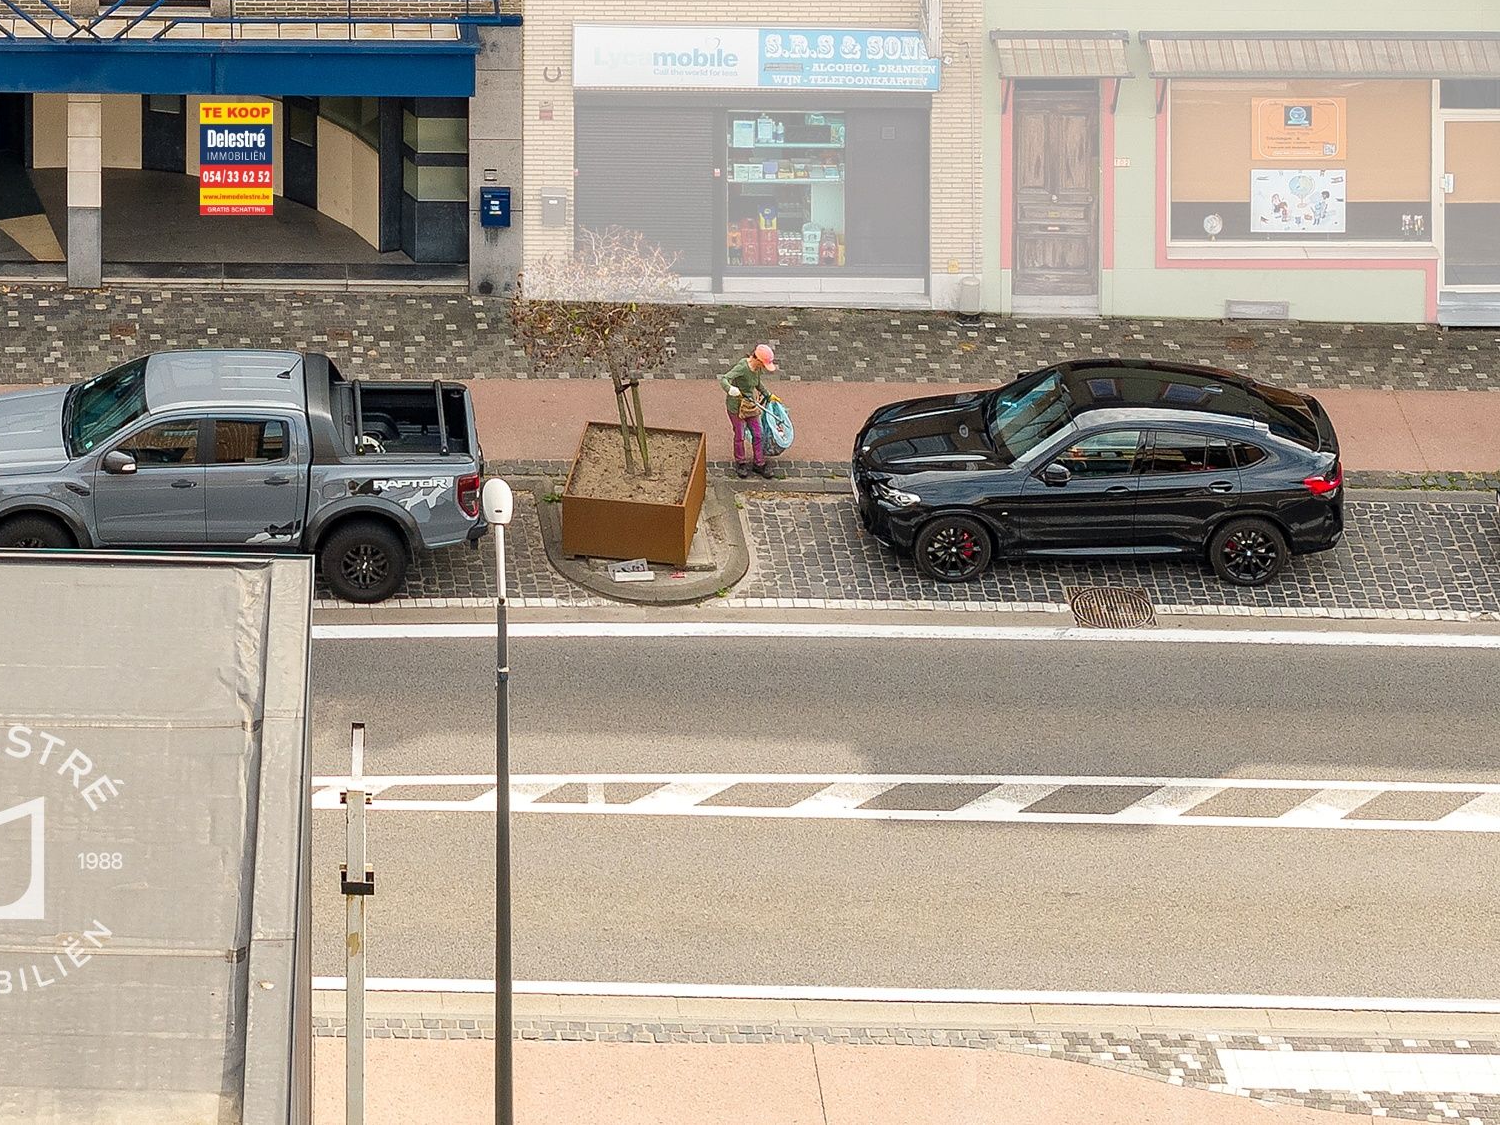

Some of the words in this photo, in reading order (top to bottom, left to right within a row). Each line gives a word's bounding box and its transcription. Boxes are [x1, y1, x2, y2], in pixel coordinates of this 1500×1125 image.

[764, 33, 835, 59] S.R.S
[839, 35, 862, 59] &
[653, 68, 669, 76] Call
[670, 68, 684, 76] the
[684, 68, 708, 76] world
[709, 69, 721, 77] for
[811, 63, 870, 73] ALCOHOL
[878, 64, 936, 74] DRANKEN
[772, 75, 802, 85] WIJN
[810, 75, 928, 86] TELEFOONKAARTEN
[202, 107, 222, 118] TE
[227, 107, 271, 118] KOOP
[207, 129, 266, 148] Delestré
[207, 150, 266, 161] IMMOBILIËN
[202, 169, 240, 183] 054/33
[242, 170, 255, 183] 62
[257, 170, 270, 183] 52
[373, 478, 447, 490] RAPTOR
